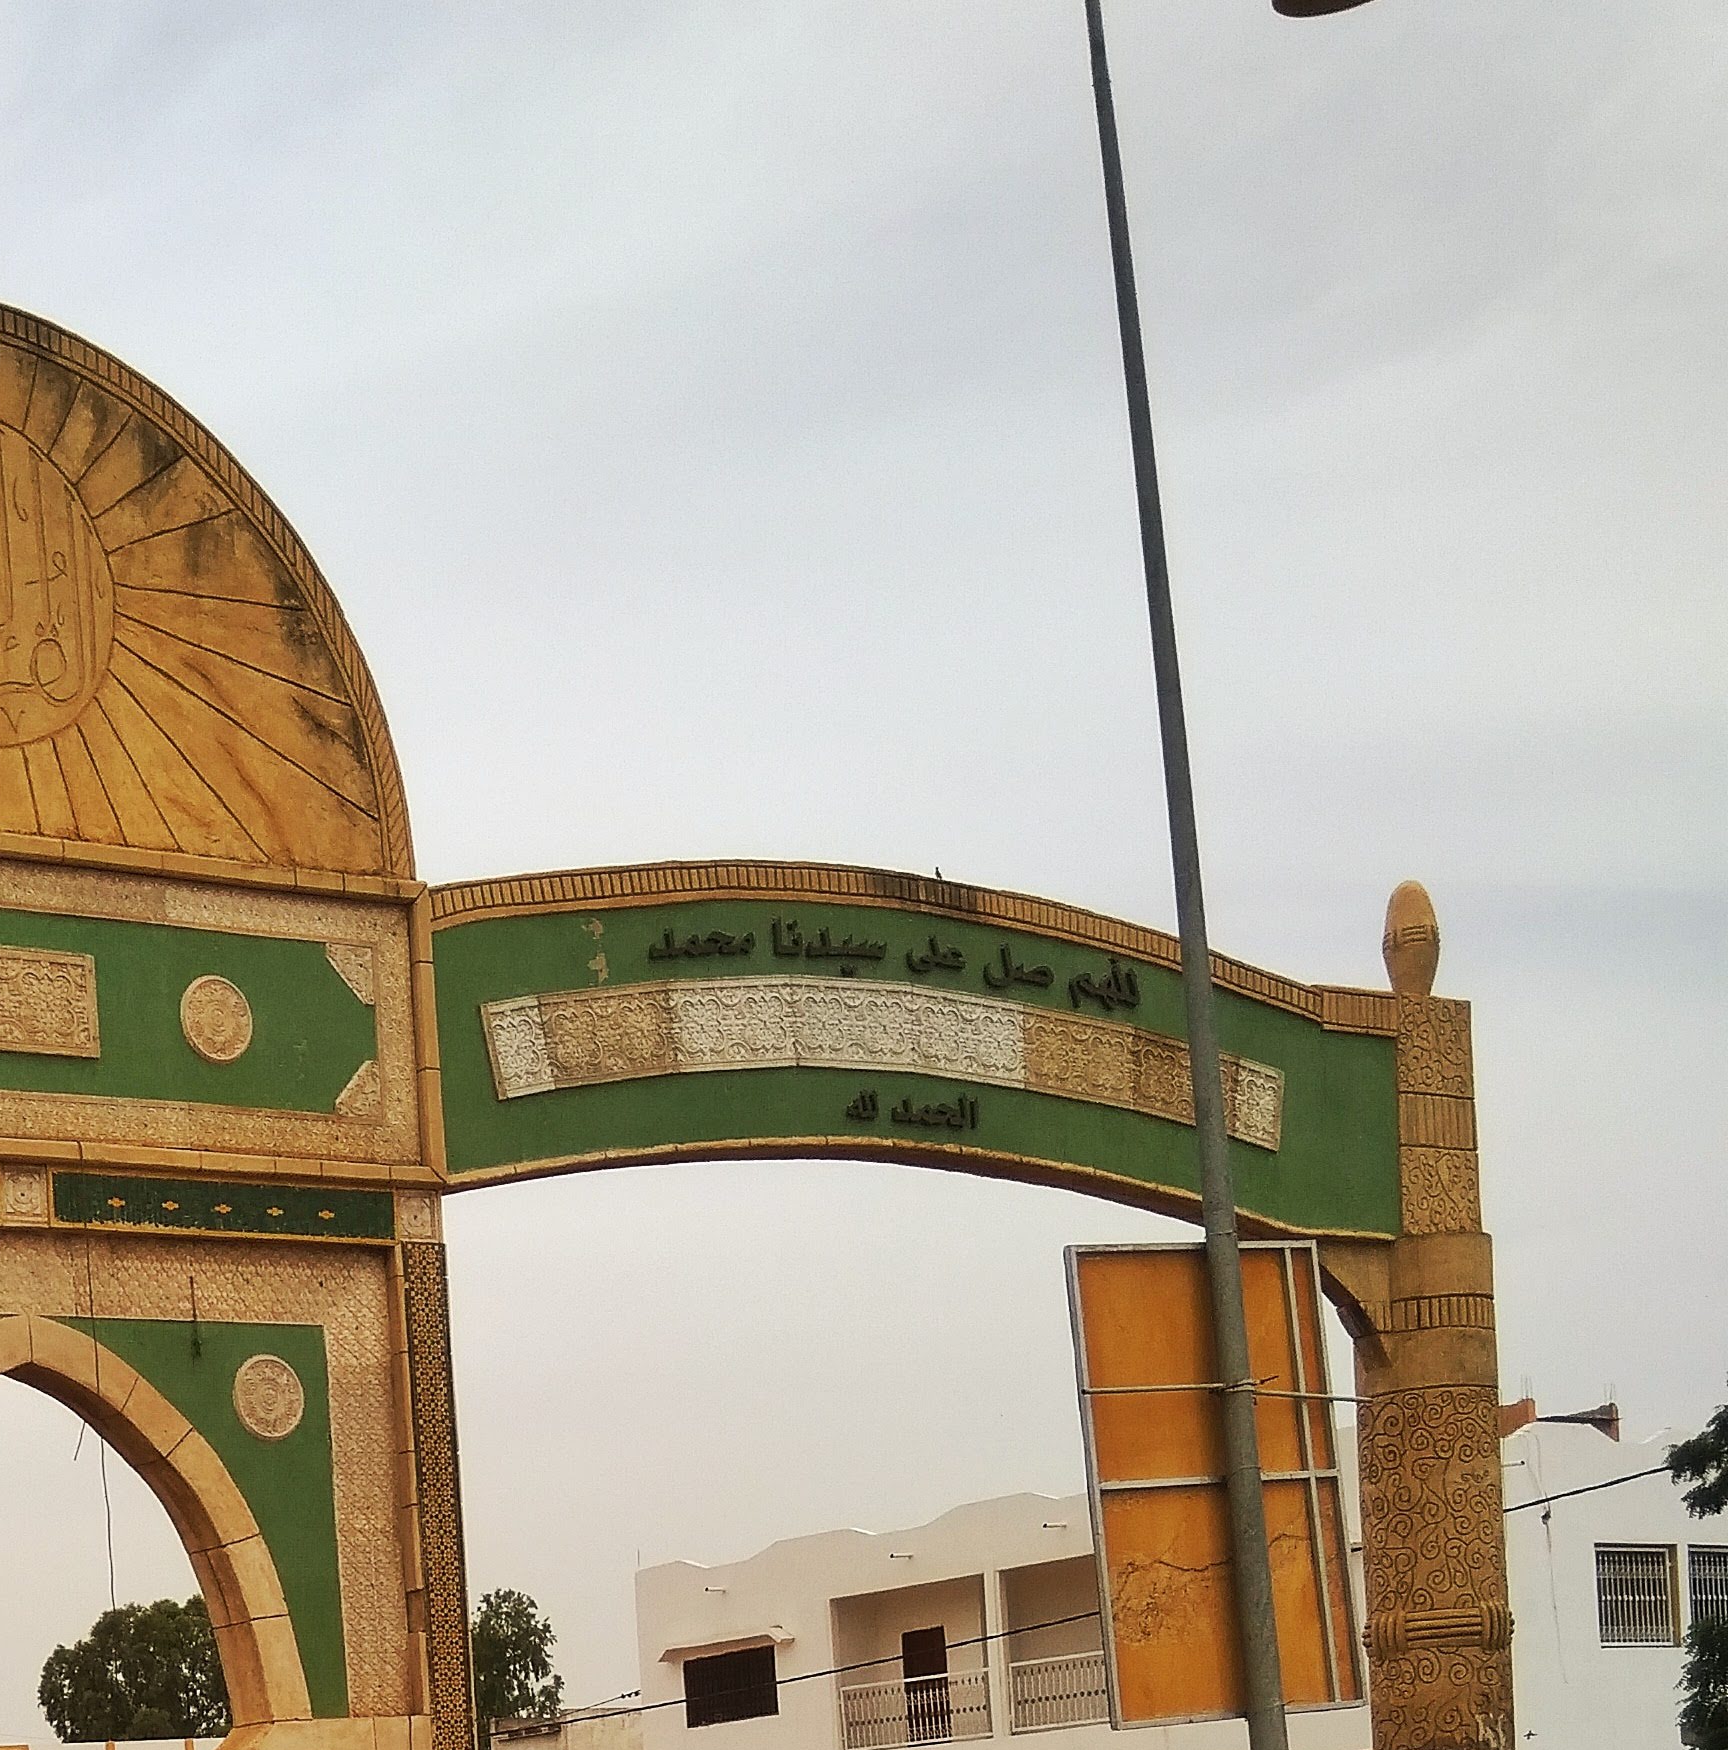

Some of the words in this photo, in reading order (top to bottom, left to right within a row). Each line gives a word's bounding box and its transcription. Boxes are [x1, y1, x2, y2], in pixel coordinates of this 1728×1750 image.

[648, 926, 756, 963] محمد
[771, 915, 888, 978] سيدنا
[905, 934, 968, 974] على
[890, 1091, 981, 1131] الحمد
